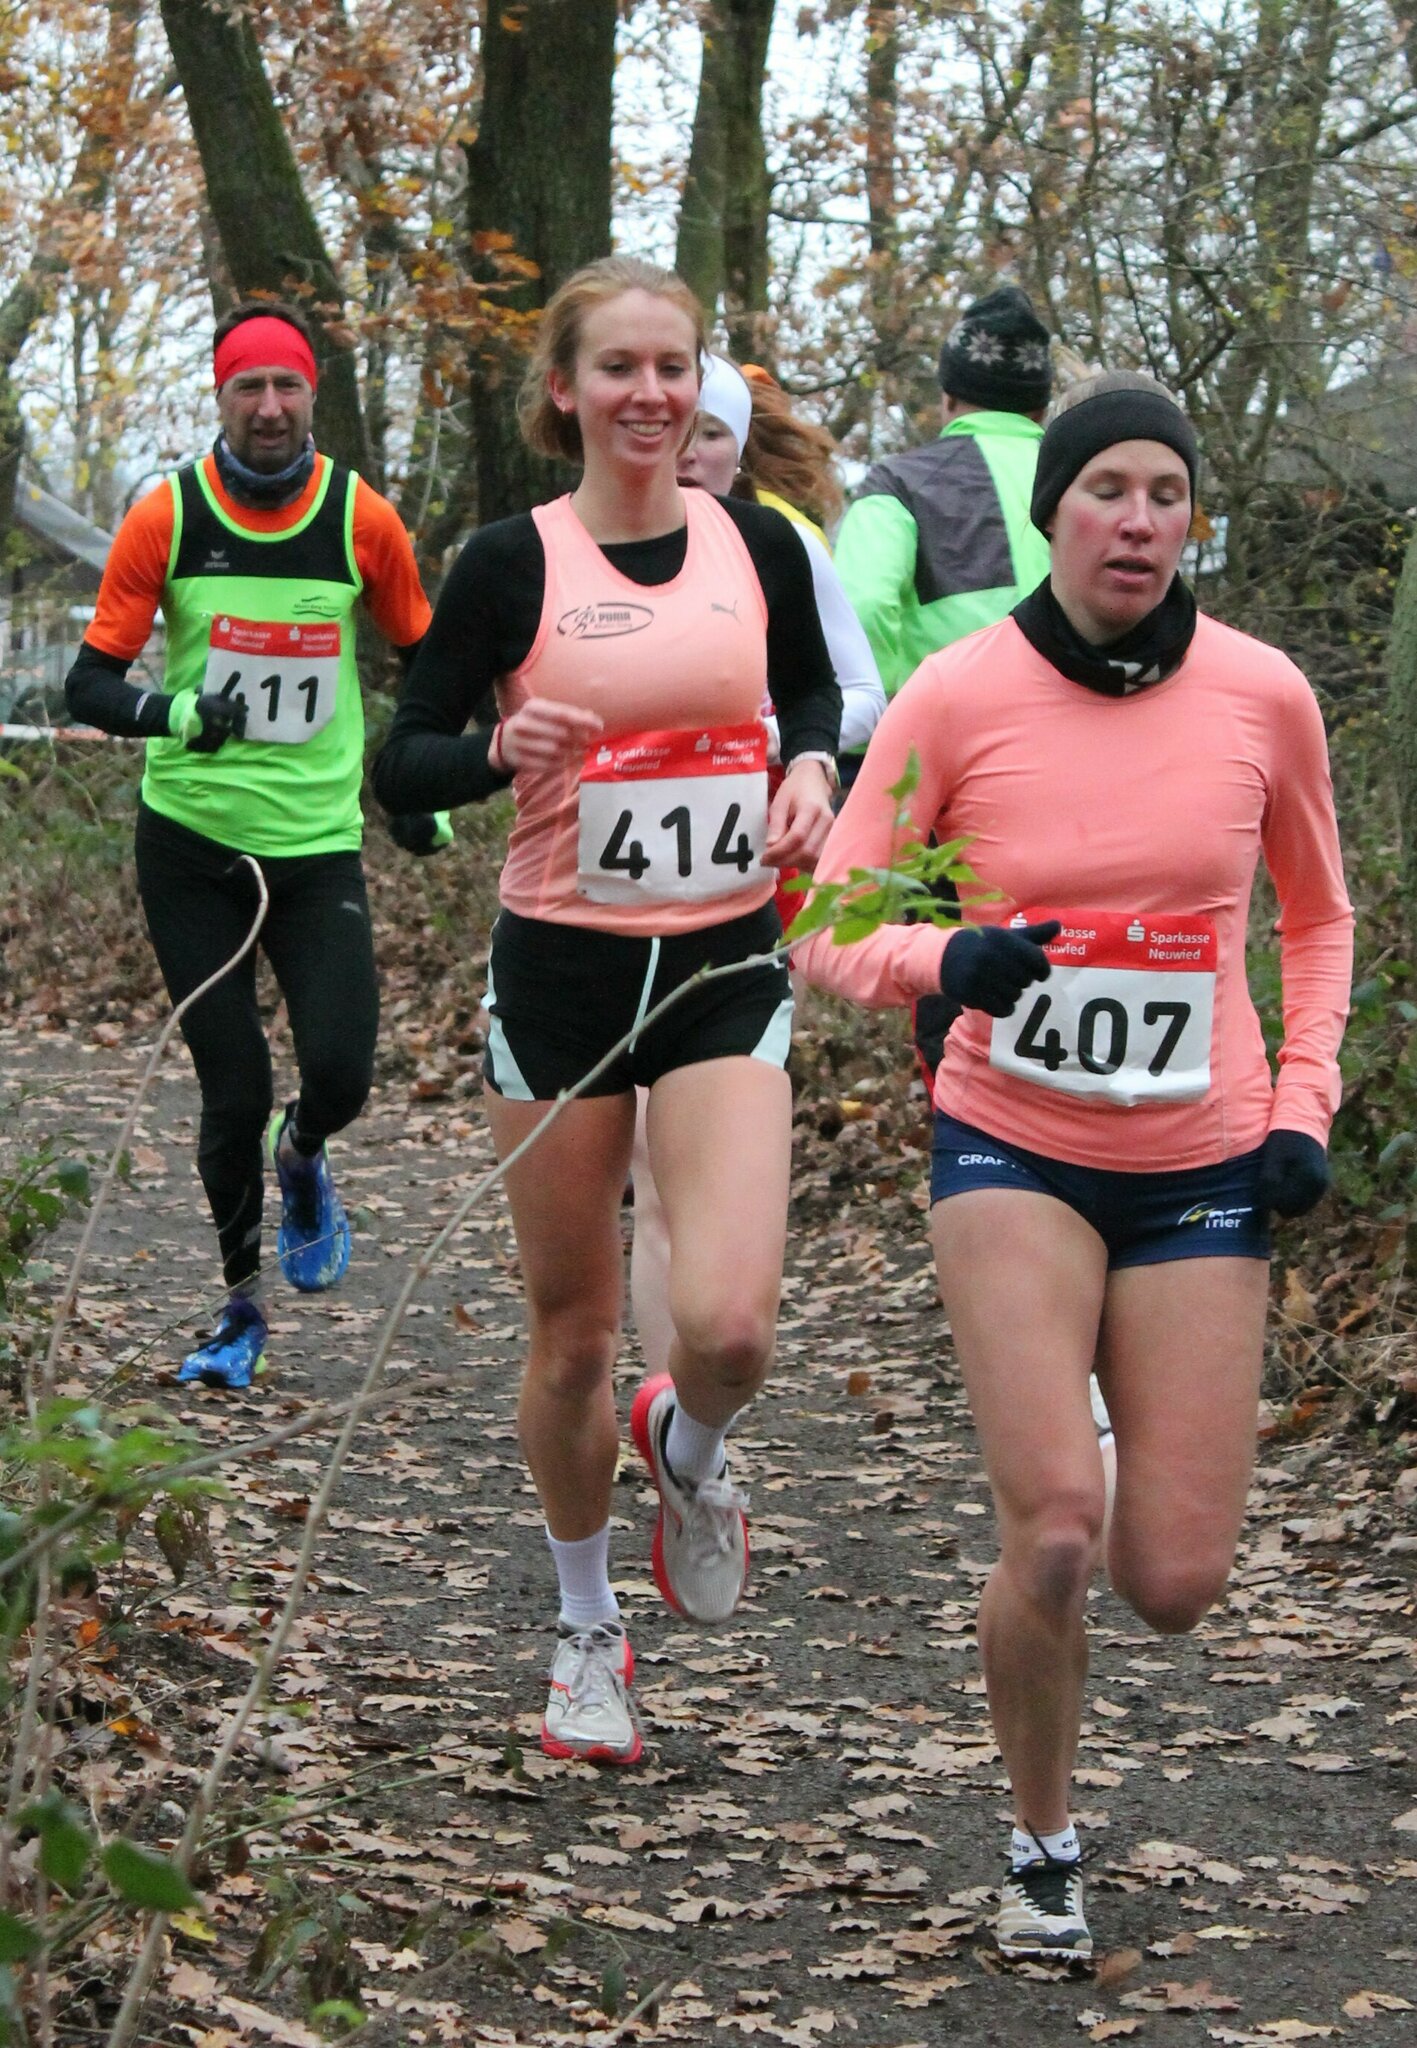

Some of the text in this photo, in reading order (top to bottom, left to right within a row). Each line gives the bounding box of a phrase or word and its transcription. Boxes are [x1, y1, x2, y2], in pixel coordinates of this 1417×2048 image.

[599, 803, 755, 880] 414
[1060, 925, 1097, 940] kasse
[1150, 930, 1211, 945] Sparkasse
[1042, 942, 1086, 956] euwied
[1149, 947, 1201, 961] Neuwied
[1014, 993, 1191, 1077] 407
[957, 1153, 1016, 1169] CRA
